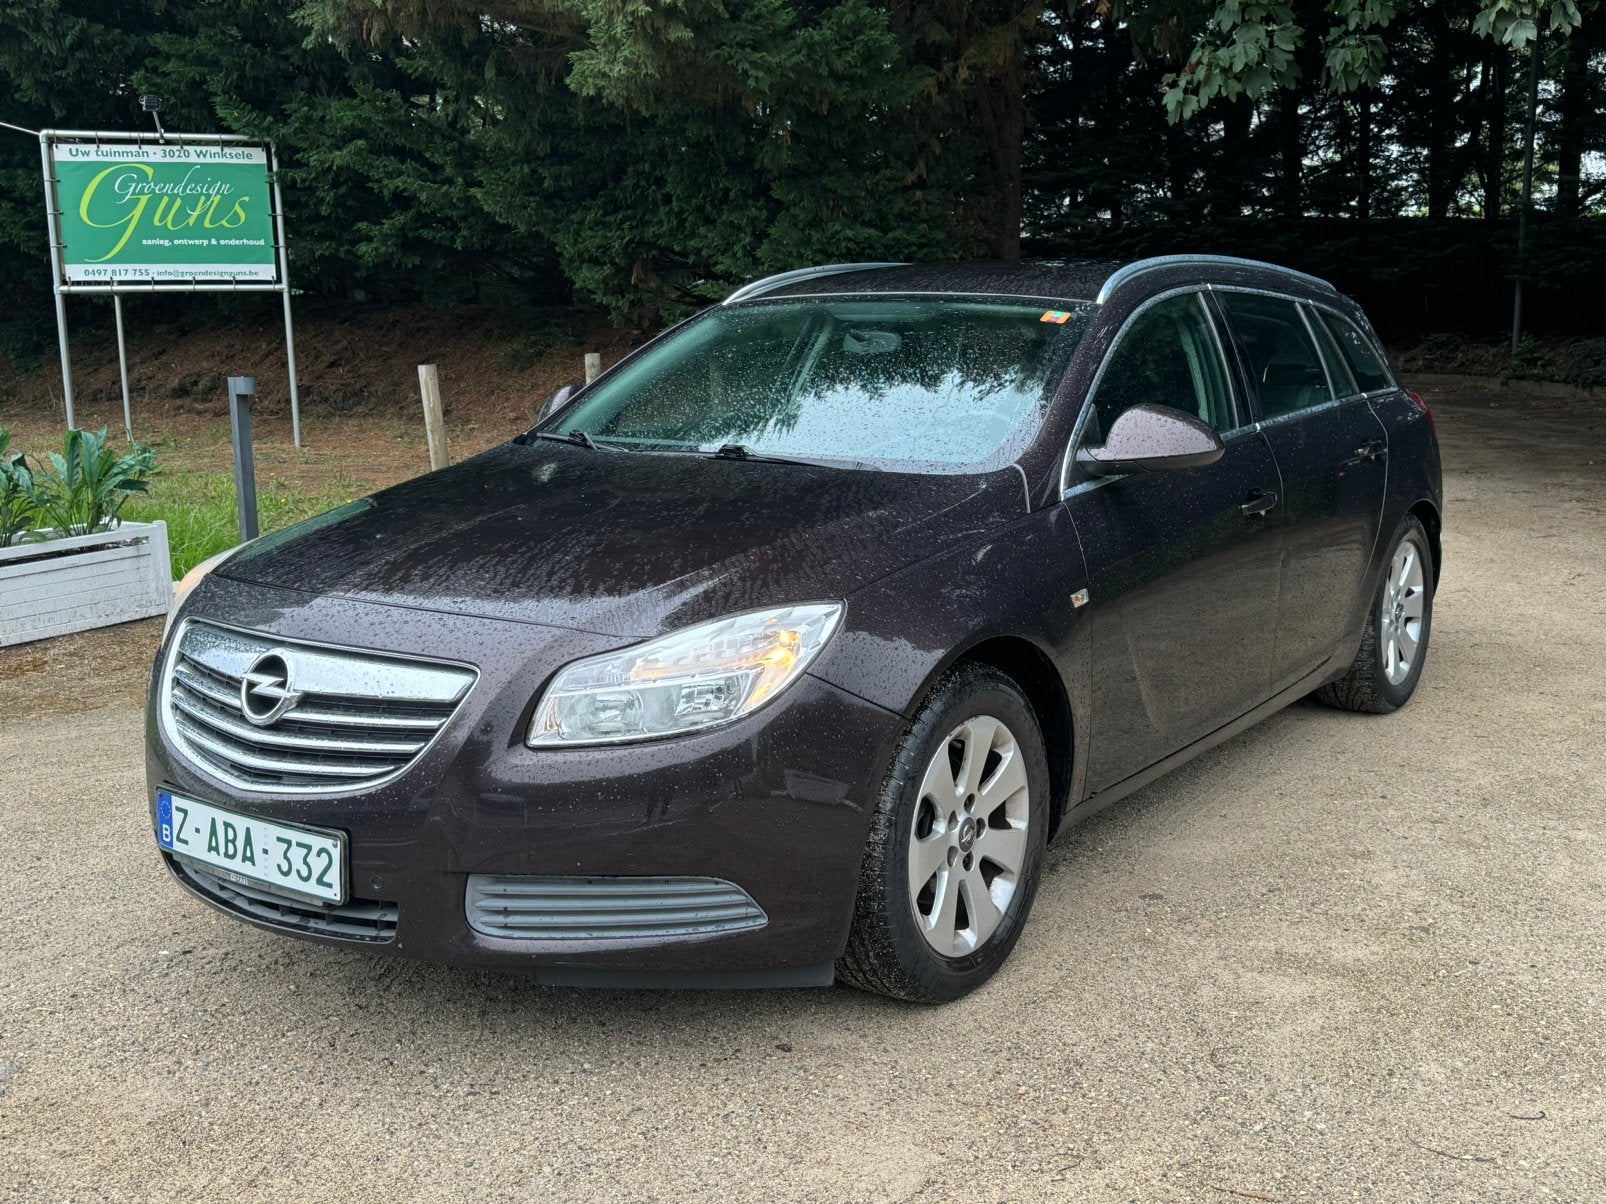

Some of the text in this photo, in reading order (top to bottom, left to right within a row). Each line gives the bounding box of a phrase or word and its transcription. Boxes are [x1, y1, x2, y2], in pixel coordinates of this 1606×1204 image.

[68, 147, 254, 160] Uw tuinman 3020 Winksele
[114, 165, 236, 214] Groendesign
[79, 163, 250, 263] Guns
[141, 238, 265, 247] aanleg, ontwerp & onderhoud
[83, 268, 260, 279] 0497 817 755 info@groendesignguns.be
[162, 824, 172, 843] B
